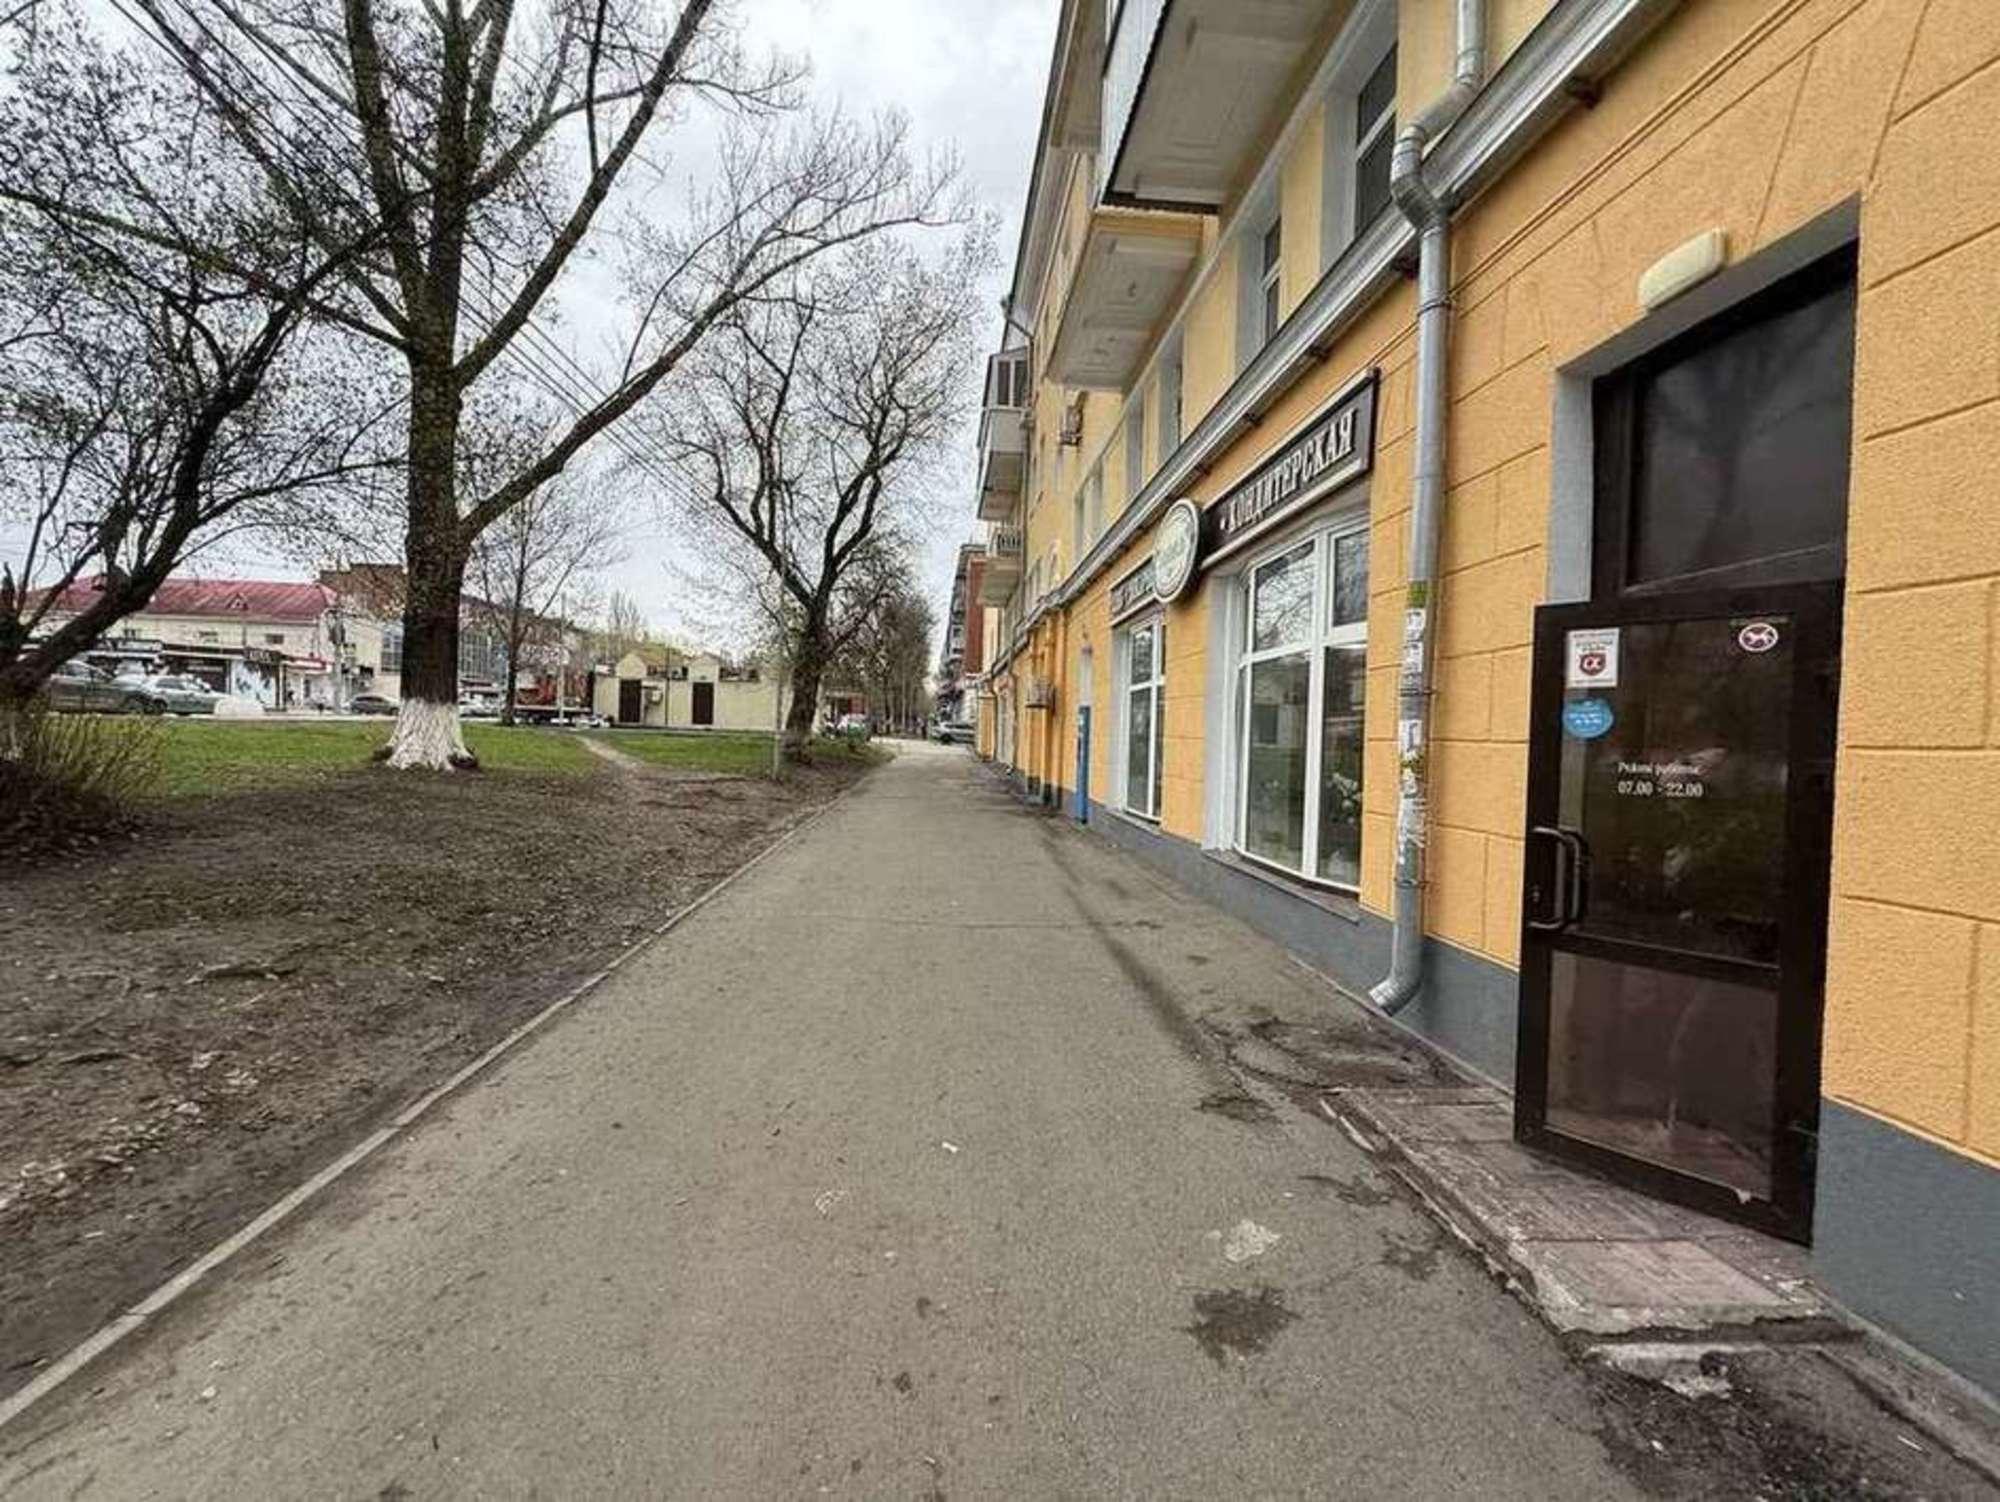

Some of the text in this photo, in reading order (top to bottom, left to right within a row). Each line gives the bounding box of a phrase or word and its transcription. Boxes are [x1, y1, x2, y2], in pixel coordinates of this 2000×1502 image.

[1228, 409, 1355, 533] КОНДИТЕРСКАЯ
[1617, 780, 1653, 797] 07.00
[1666, 781, 1704, 798] 22.00
